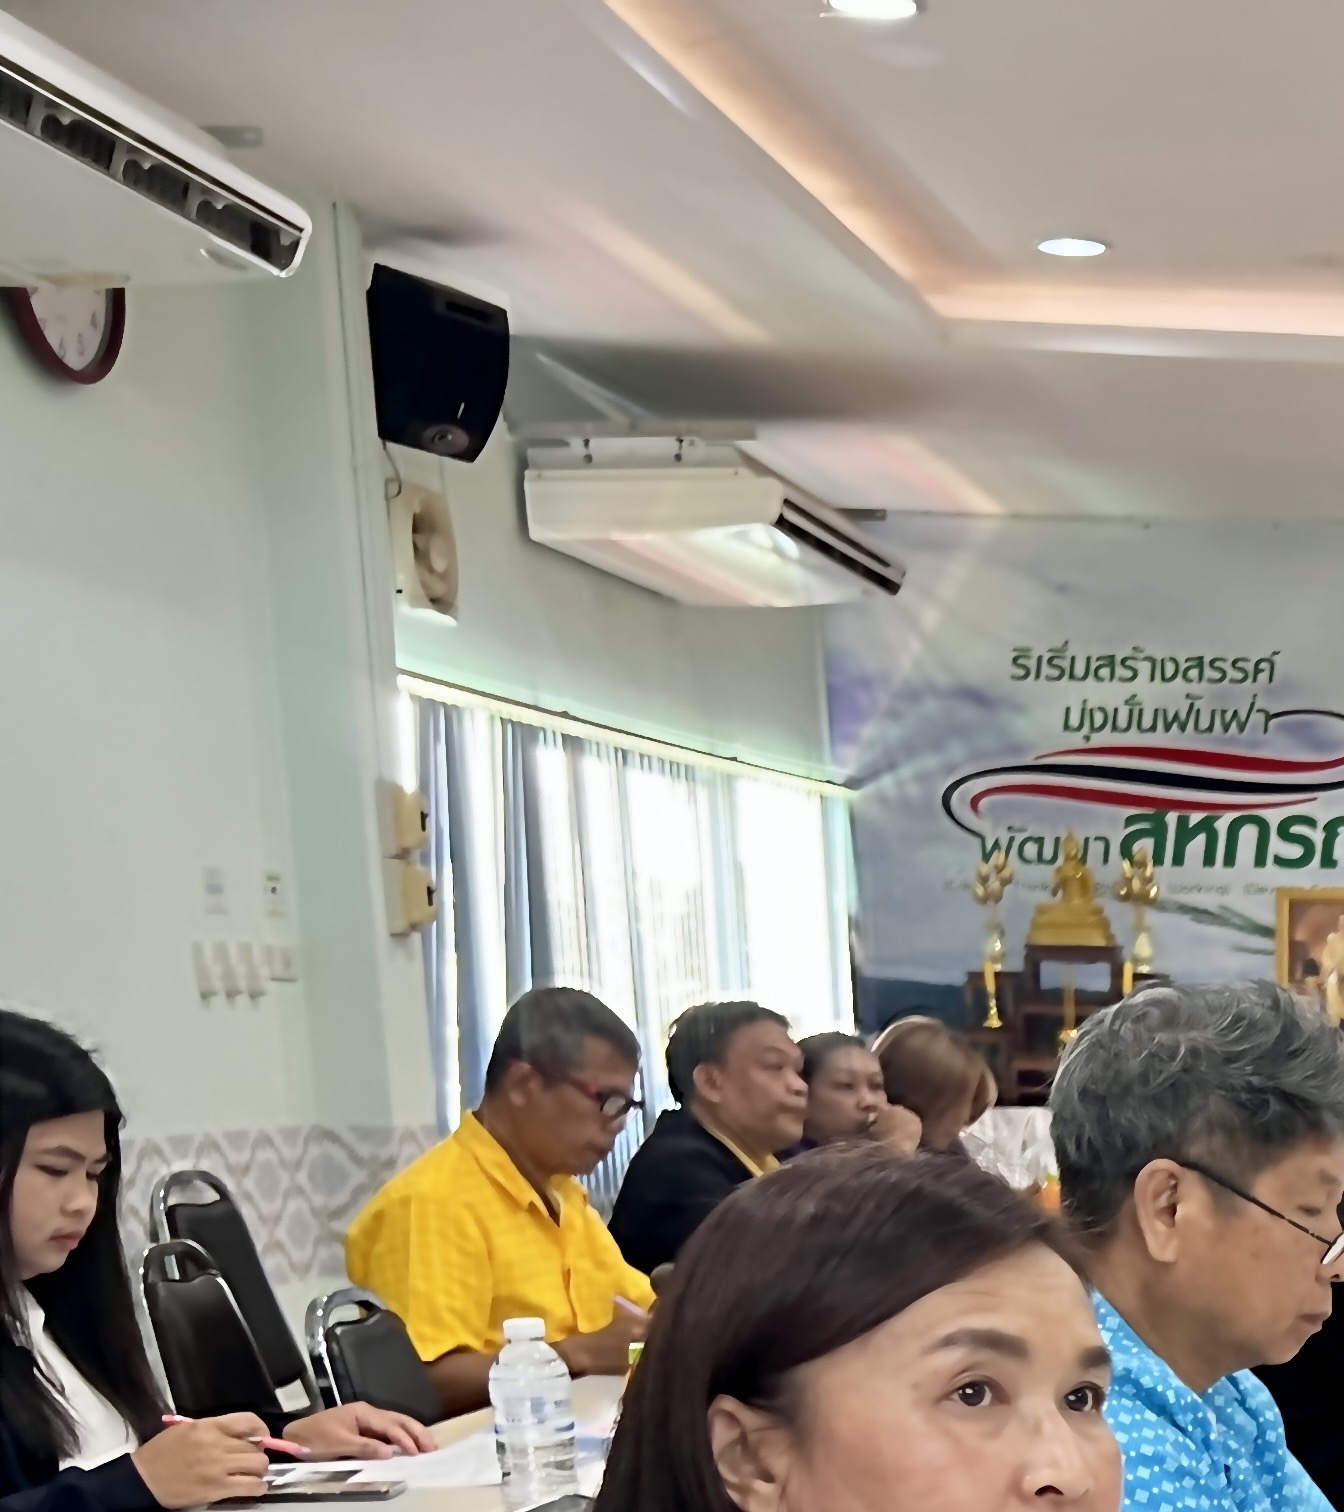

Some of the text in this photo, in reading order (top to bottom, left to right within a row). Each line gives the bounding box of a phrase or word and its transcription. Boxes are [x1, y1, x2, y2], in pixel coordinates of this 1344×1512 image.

[1010, 640, 1281, 685] ริเริ่มสร้างสรรค์
